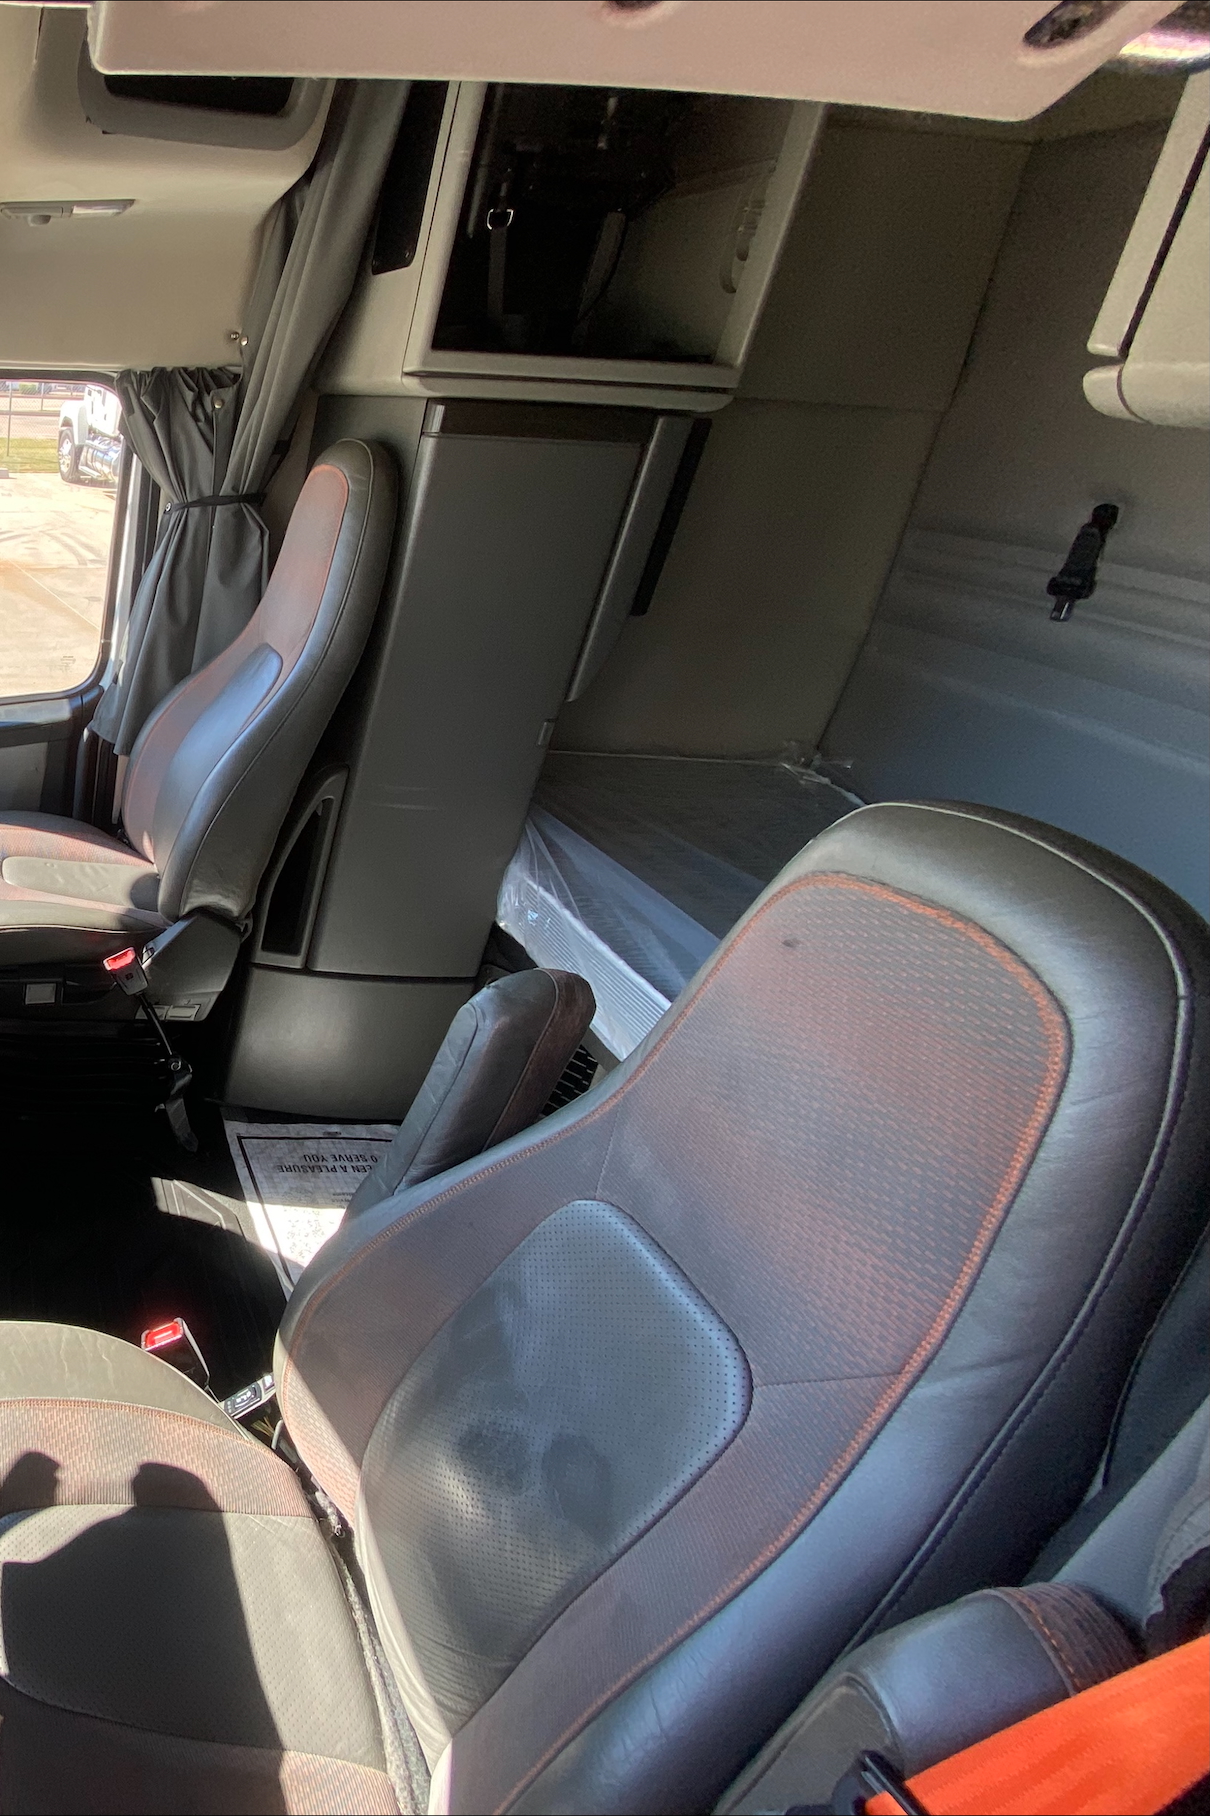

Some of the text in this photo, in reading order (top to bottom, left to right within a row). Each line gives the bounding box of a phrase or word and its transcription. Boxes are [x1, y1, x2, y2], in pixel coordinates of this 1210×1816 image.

[303, 1154, 327, 1162] YOU
[330, 1154, 368, 1163] SERVE
[277, 1164, 338, 1173] PLEASURE
[340, 1164, 348, 1173] A
